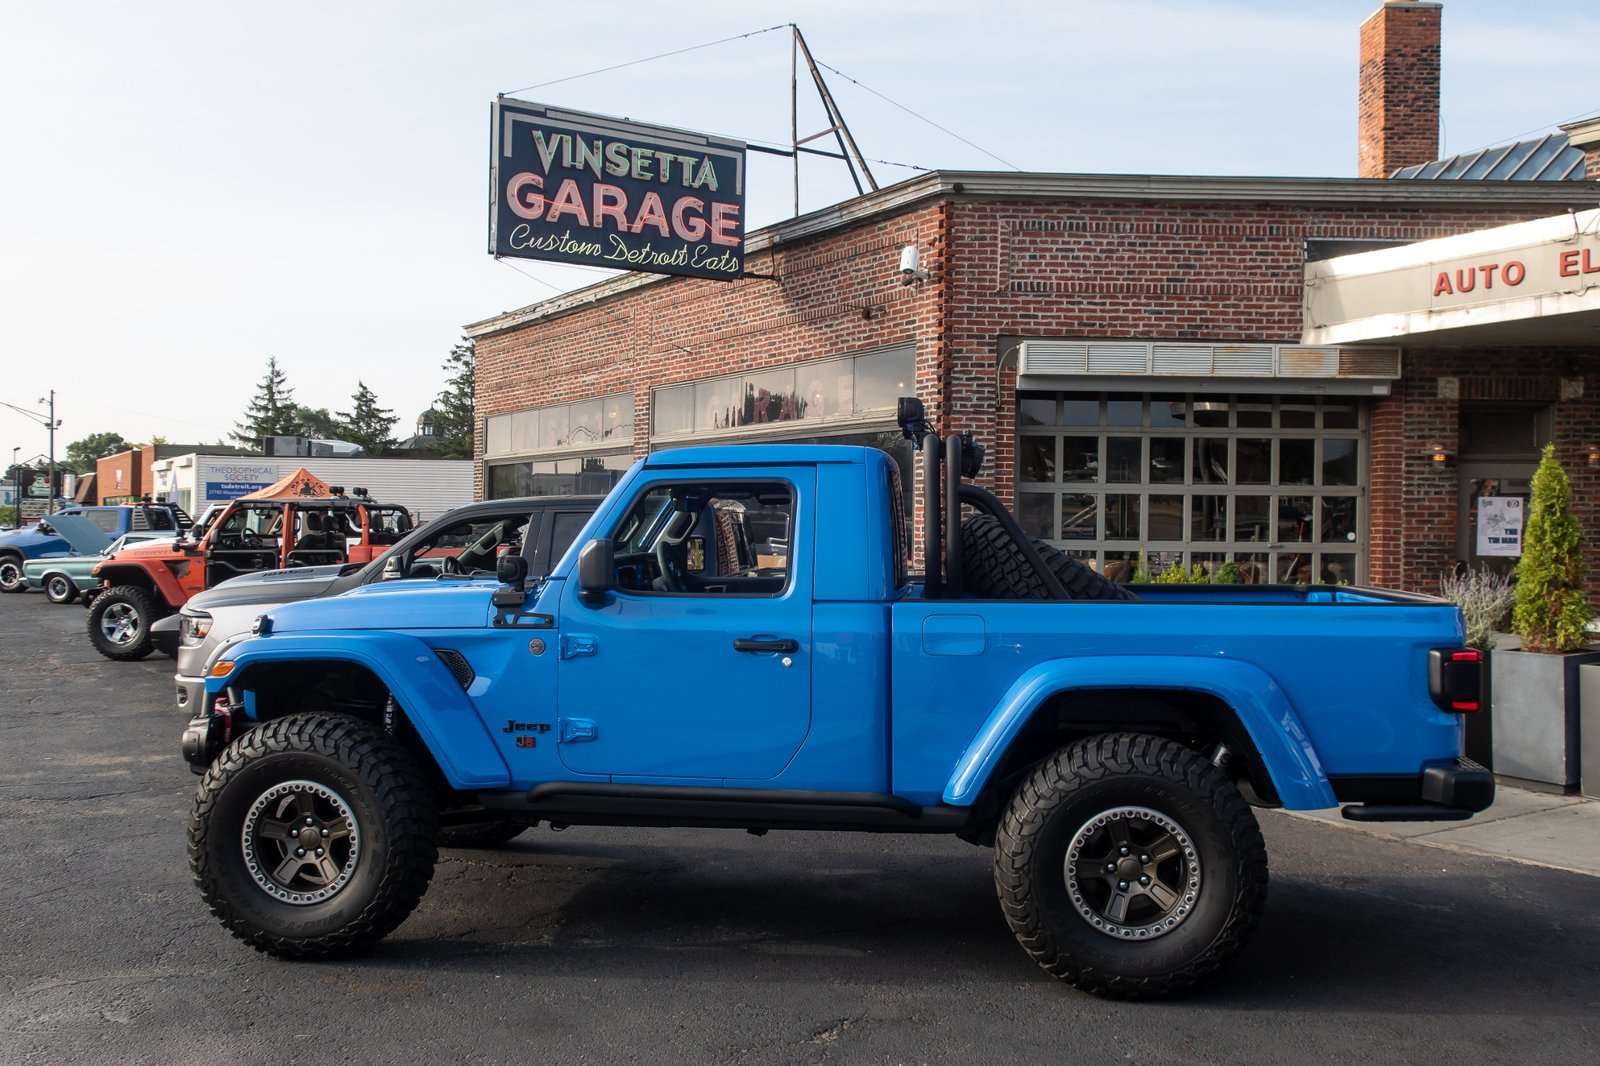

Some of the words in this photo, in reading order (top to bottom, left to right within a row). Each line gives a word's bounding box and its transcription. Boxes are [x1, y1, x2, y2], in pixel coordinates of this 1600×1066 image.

[531, 129, 718, 192] VINSETTA
[506, 172, 742, 247] GARAGE
[509, 223, 601, 256] Custom
[604, 233, 688, 266] Detroit
[691, 244, 739, 273] Eats
[1433, 261, 1525, 296] AUTO
[210, 466, 273, 474] THEOSOPHICAL
[502, 720, 550, 733] Jeep
